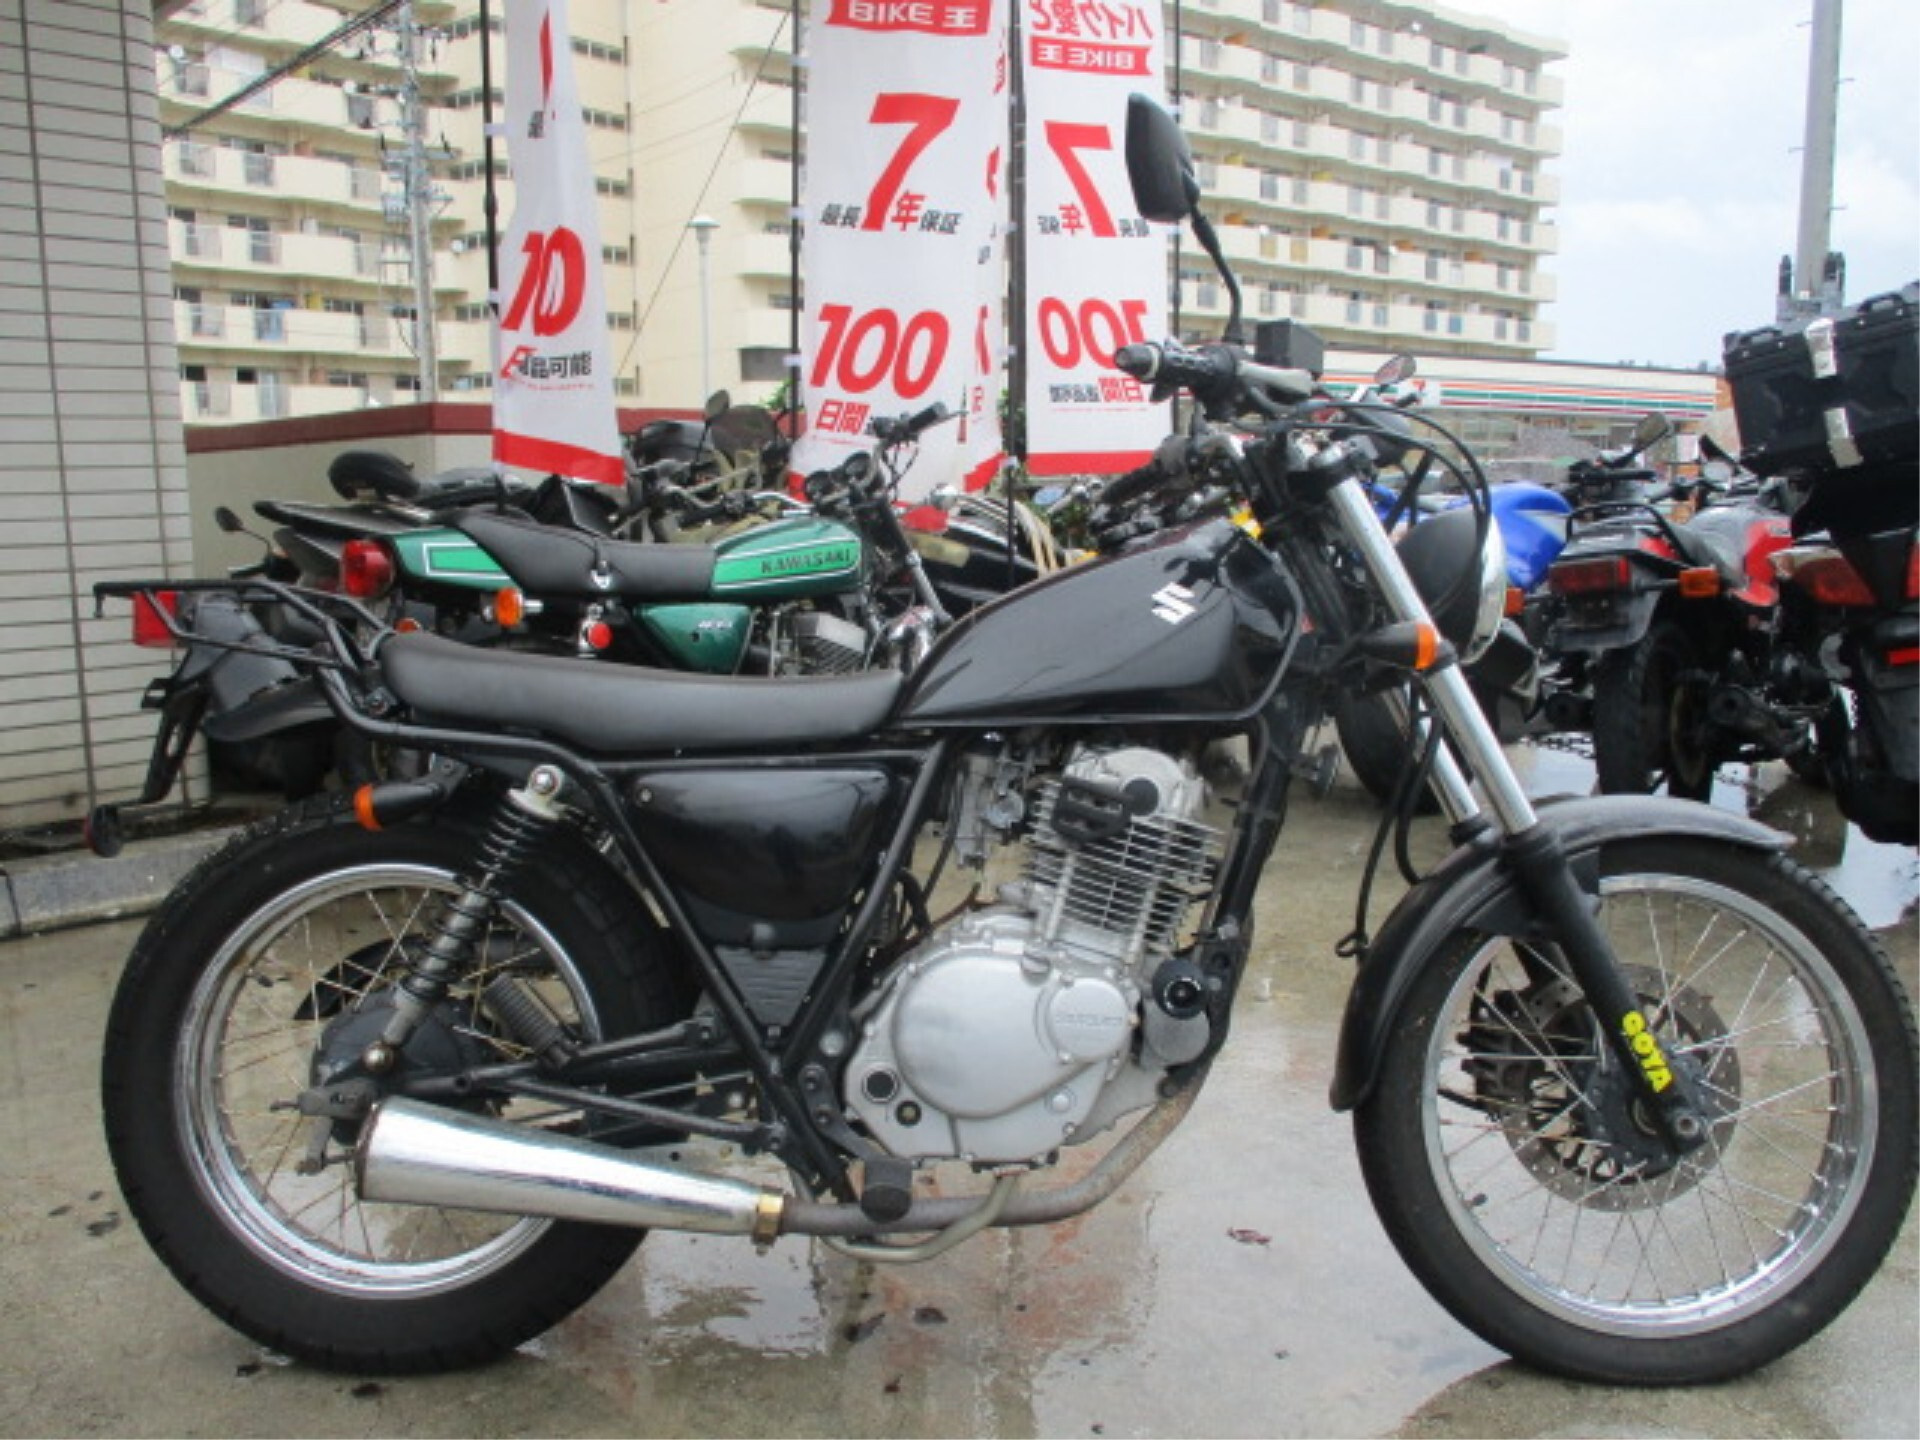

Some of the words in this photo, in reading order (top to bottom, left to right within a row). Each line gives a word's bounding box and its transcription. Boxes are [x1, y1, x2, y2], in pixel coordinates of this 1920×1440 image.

[848, 2, 934, 25] BIKE
[942, 6, 978, 28] 王
[810, 303, 950, 399] 100
[760, 547, 851, 575] KAWASAKI
